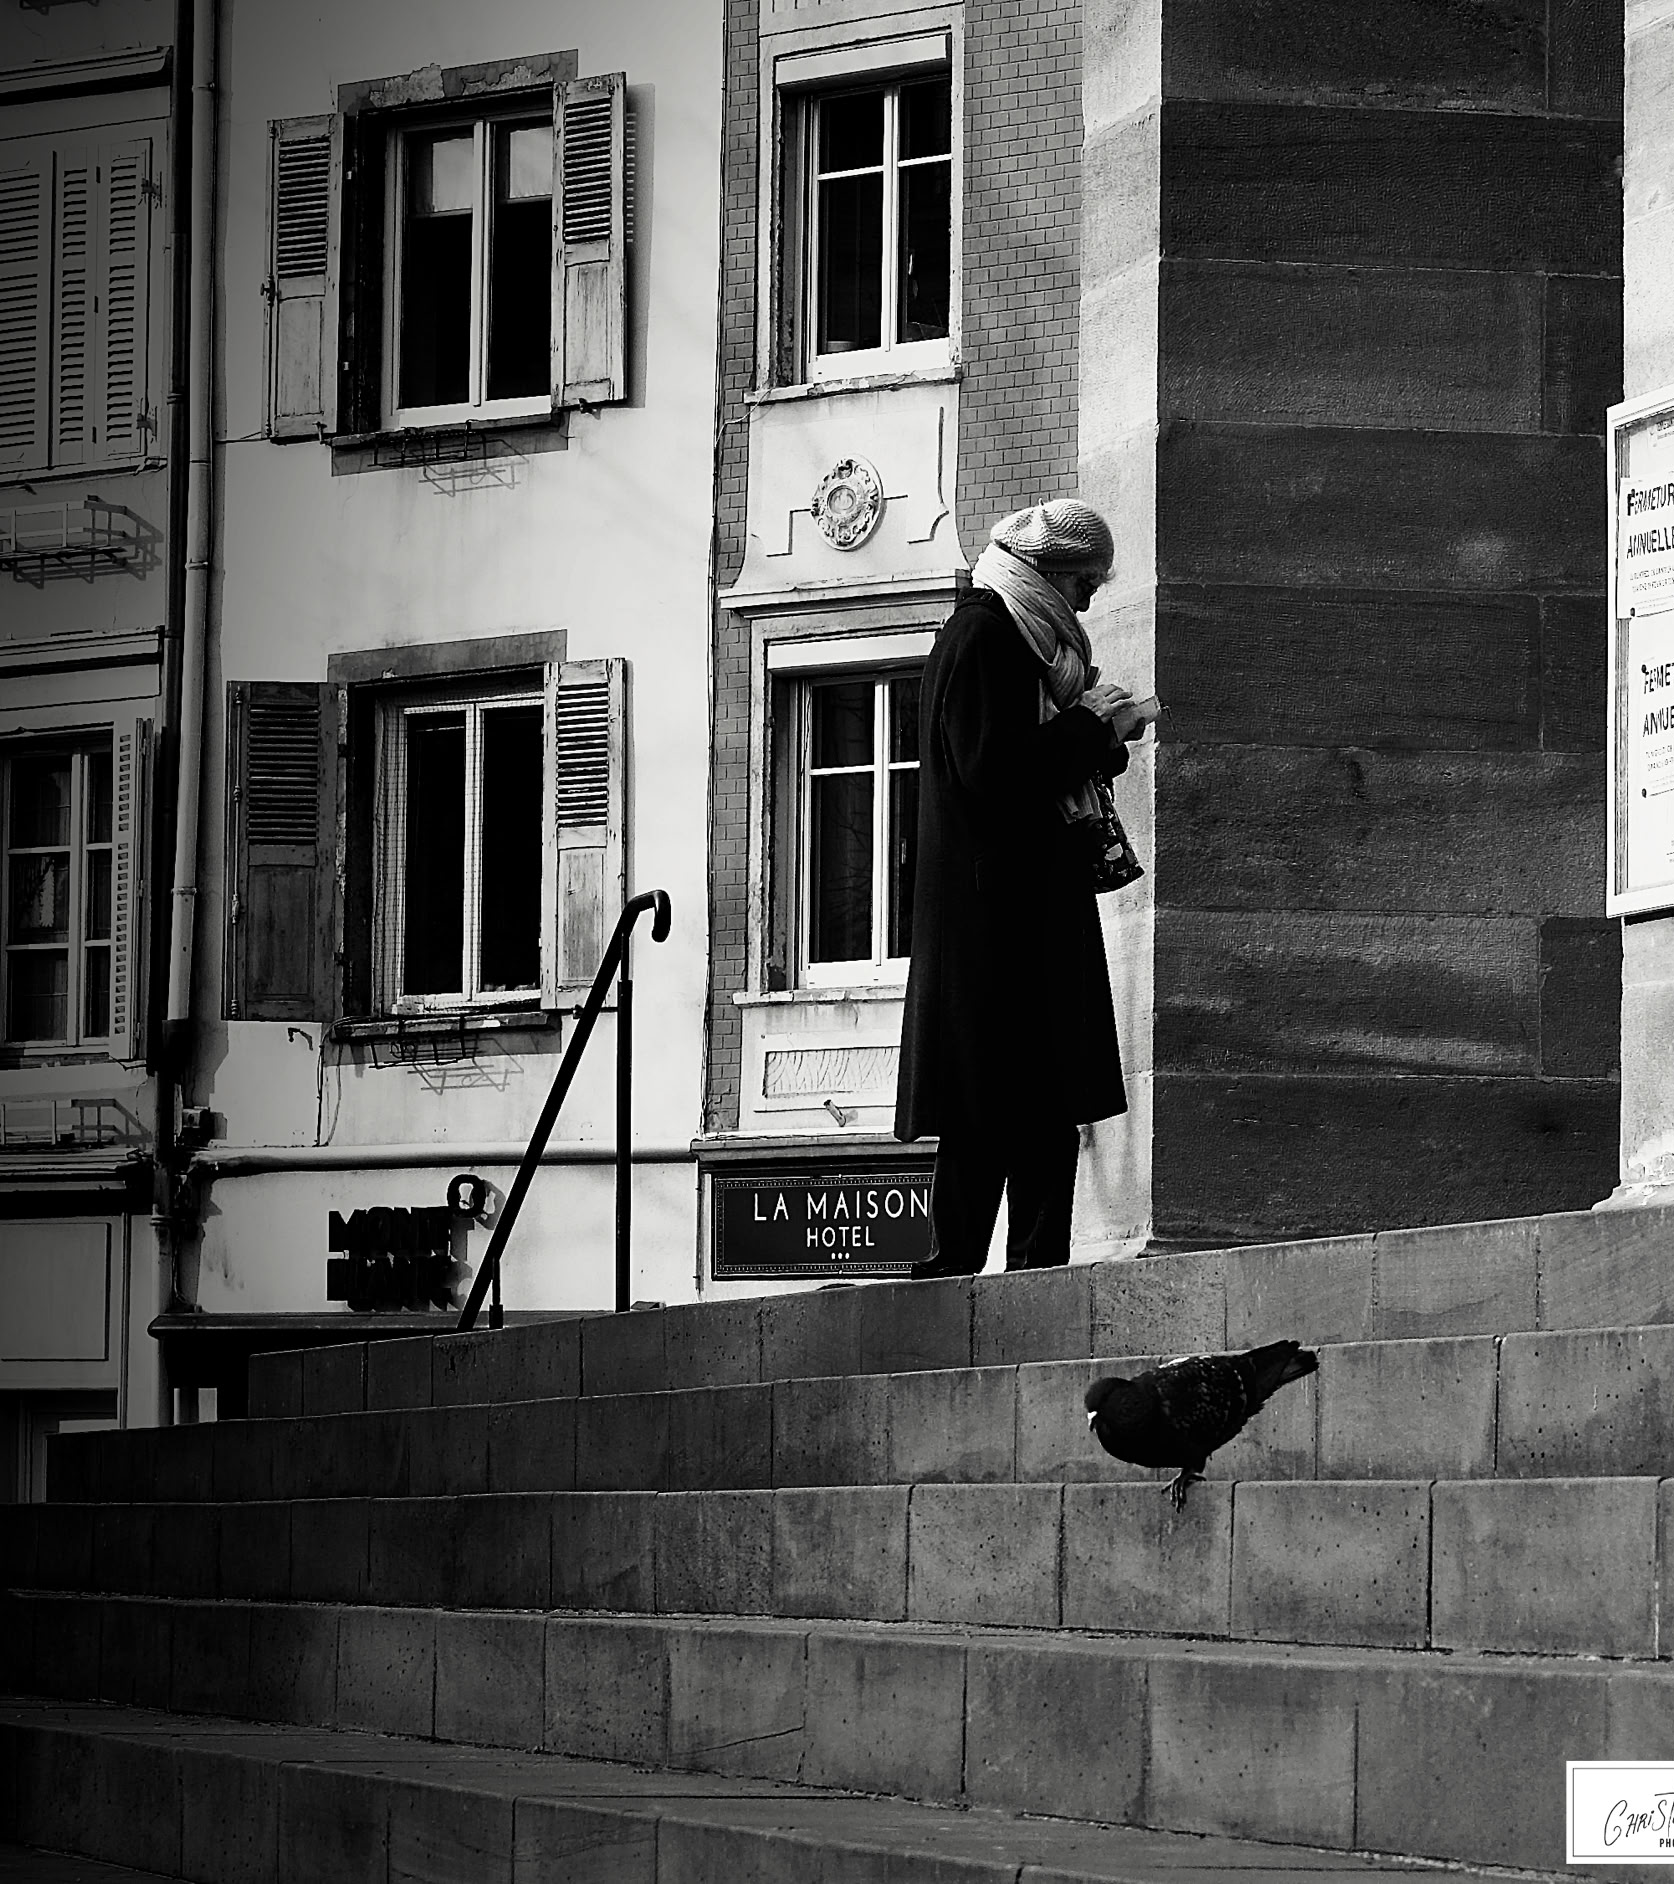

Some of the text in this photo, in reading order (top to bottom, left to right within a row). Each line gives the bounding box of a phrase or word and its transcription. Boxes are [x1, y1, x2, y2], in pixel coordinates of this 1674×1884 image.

[754, 1188, 929, 1221] LA MAISON
[806, 1226, 875, 1248] HOTEL
